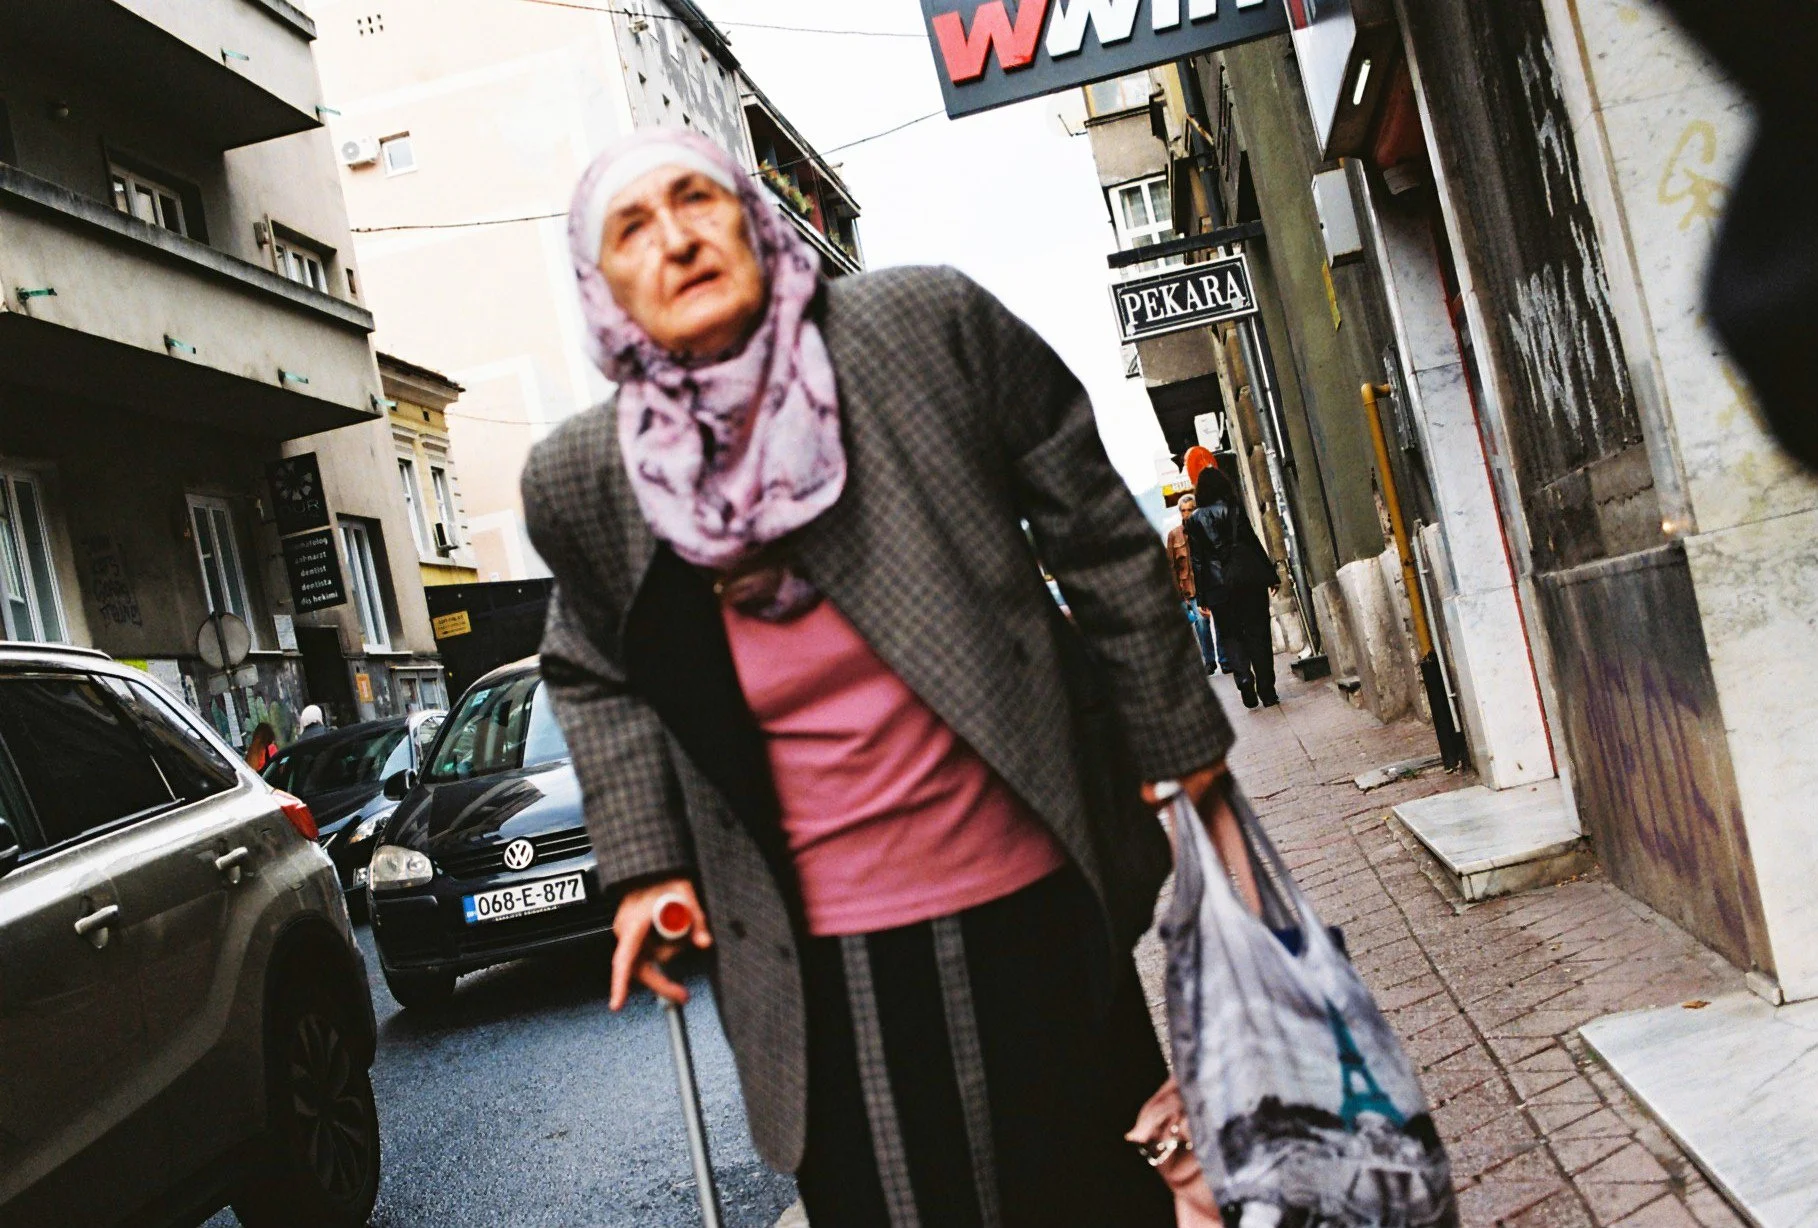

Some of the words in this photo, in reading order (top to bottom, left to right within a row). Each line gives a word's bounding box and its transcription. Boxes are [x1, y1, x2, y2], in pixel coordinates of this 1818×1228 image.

[1121, 270, 1246, 326] PEKARA
[300, 565, 327, 577] dentist
[301, 578, 332, 591] dentista
[478, 878, 579, 916] 068-E-877
